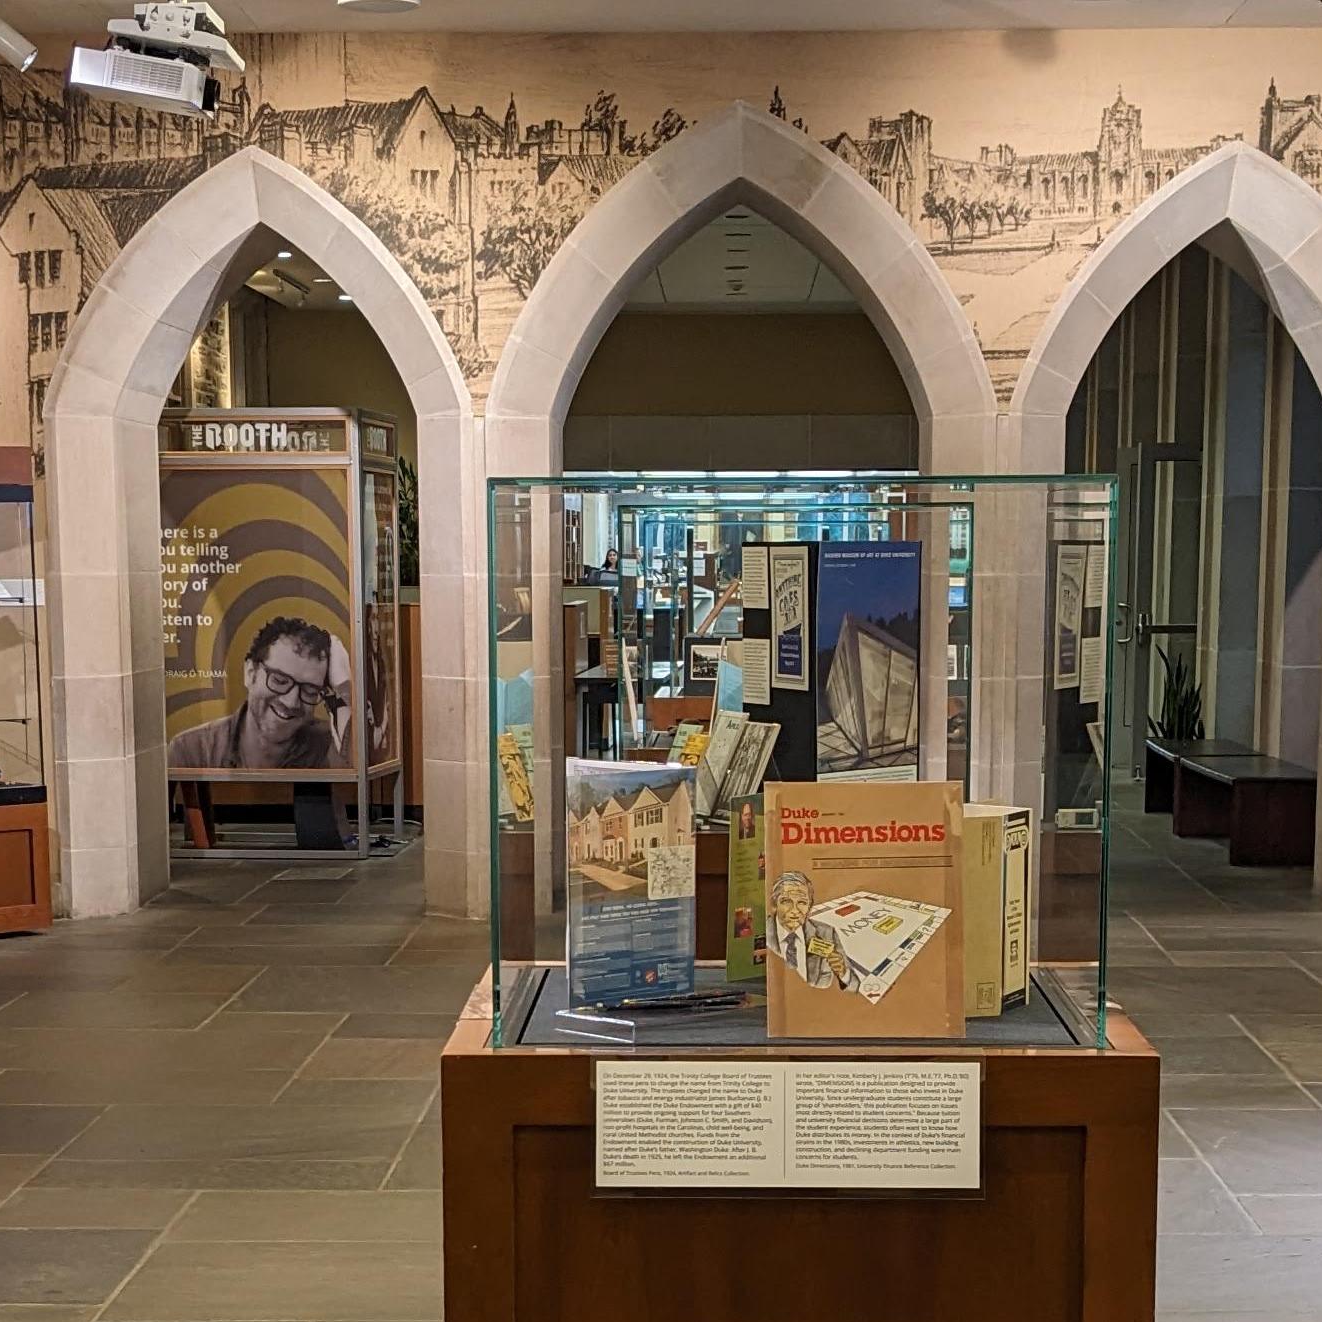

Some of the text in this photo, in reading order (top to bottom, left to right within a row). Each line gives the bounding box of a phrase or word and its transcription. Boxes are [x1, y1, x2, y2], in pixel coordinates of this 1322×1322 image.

[192, 424, 203, 447] THE
[205, 422, 288, 450] BOOTH
[193, 525, 205, 539] is
[209, 528, 218, 539] a
[180, 543, 229, 560] telling
[181, 561, 241, 574] another
[192, 578, 208, 592] of
[196, 614, 213, 626] to
[781, 808, 819, 819] Duke
[782, 821, 945, 845] Dimensions
[841, 907, 893, 937] MONEY
